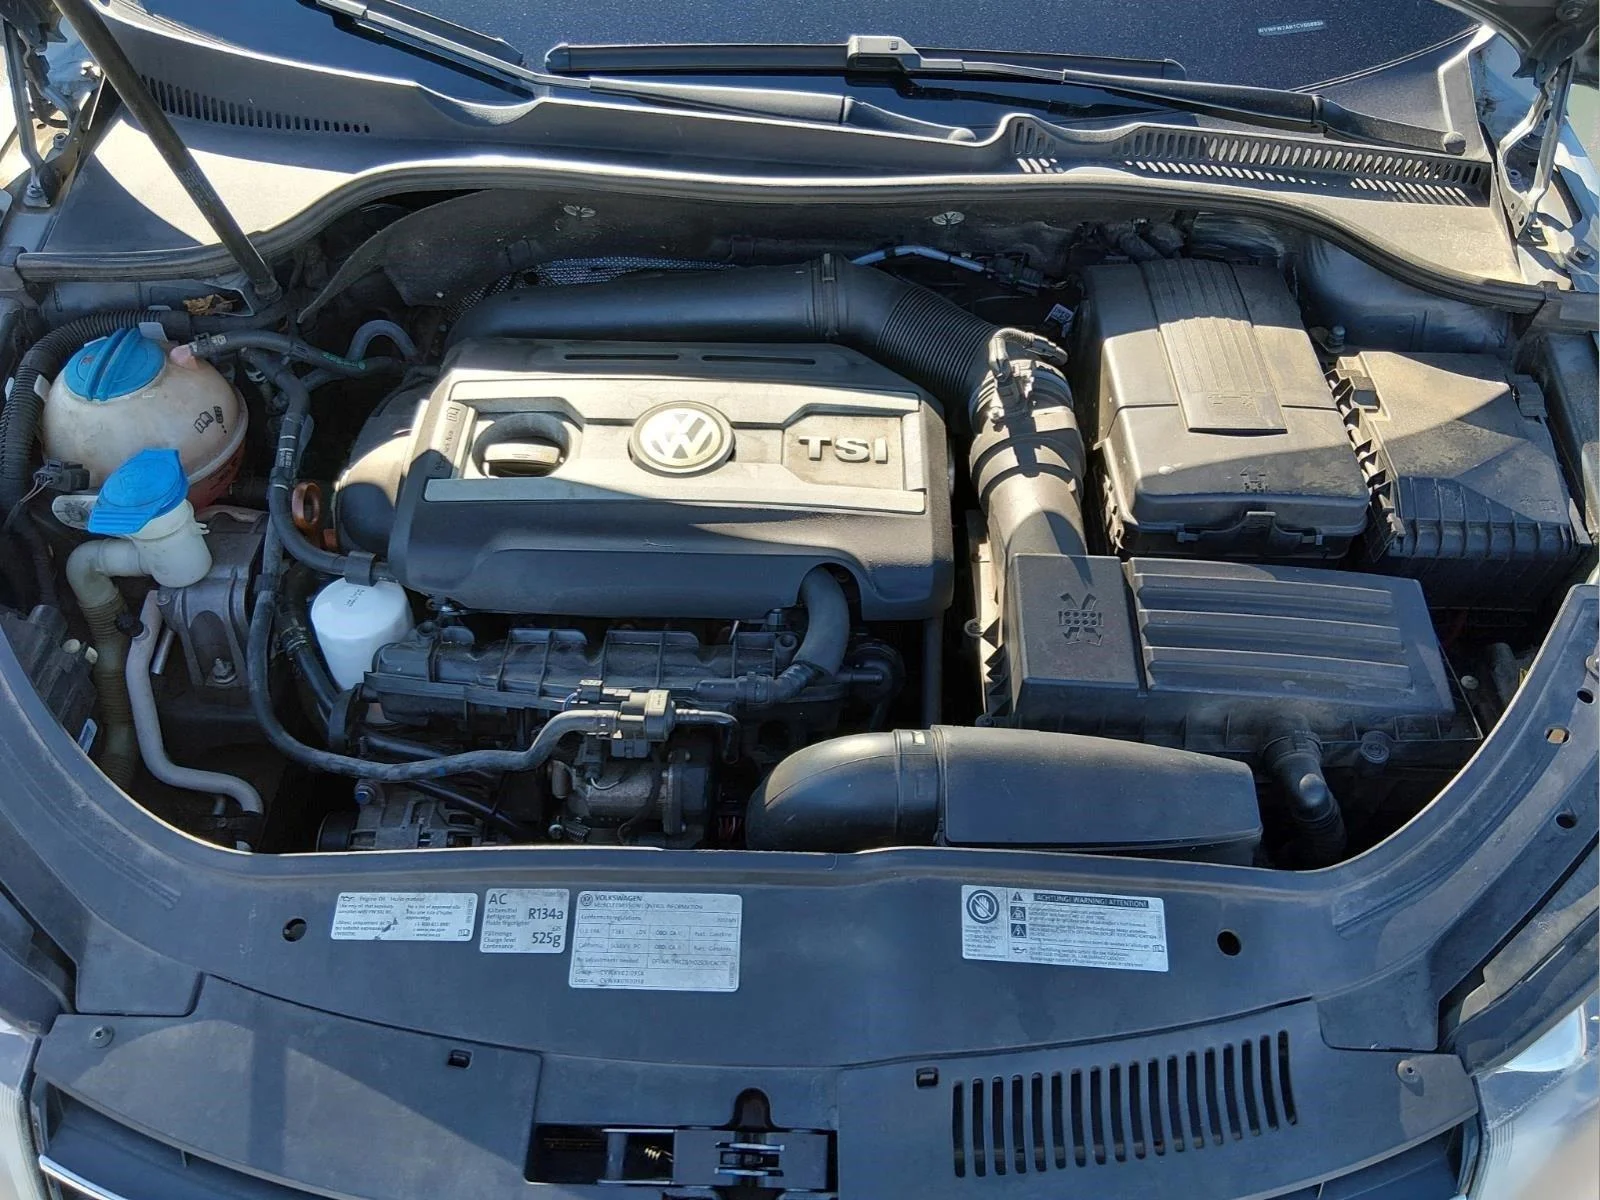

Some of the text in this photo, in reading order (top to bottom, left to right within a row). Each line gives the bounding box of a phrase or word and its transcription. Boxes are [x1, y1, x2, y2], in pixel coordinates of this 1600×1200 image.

[798, 436, 888, 464] TSI
[488, 894, 508, 904] AC
[594, 894, 642, 902] VOLKSWAGEN
[1036, 894, 1147, 908] ACHTUNG! WARNING! ATTENTION!
[528, 908, 564, 920] R134a
[532, 932, 562, 948] 525g
